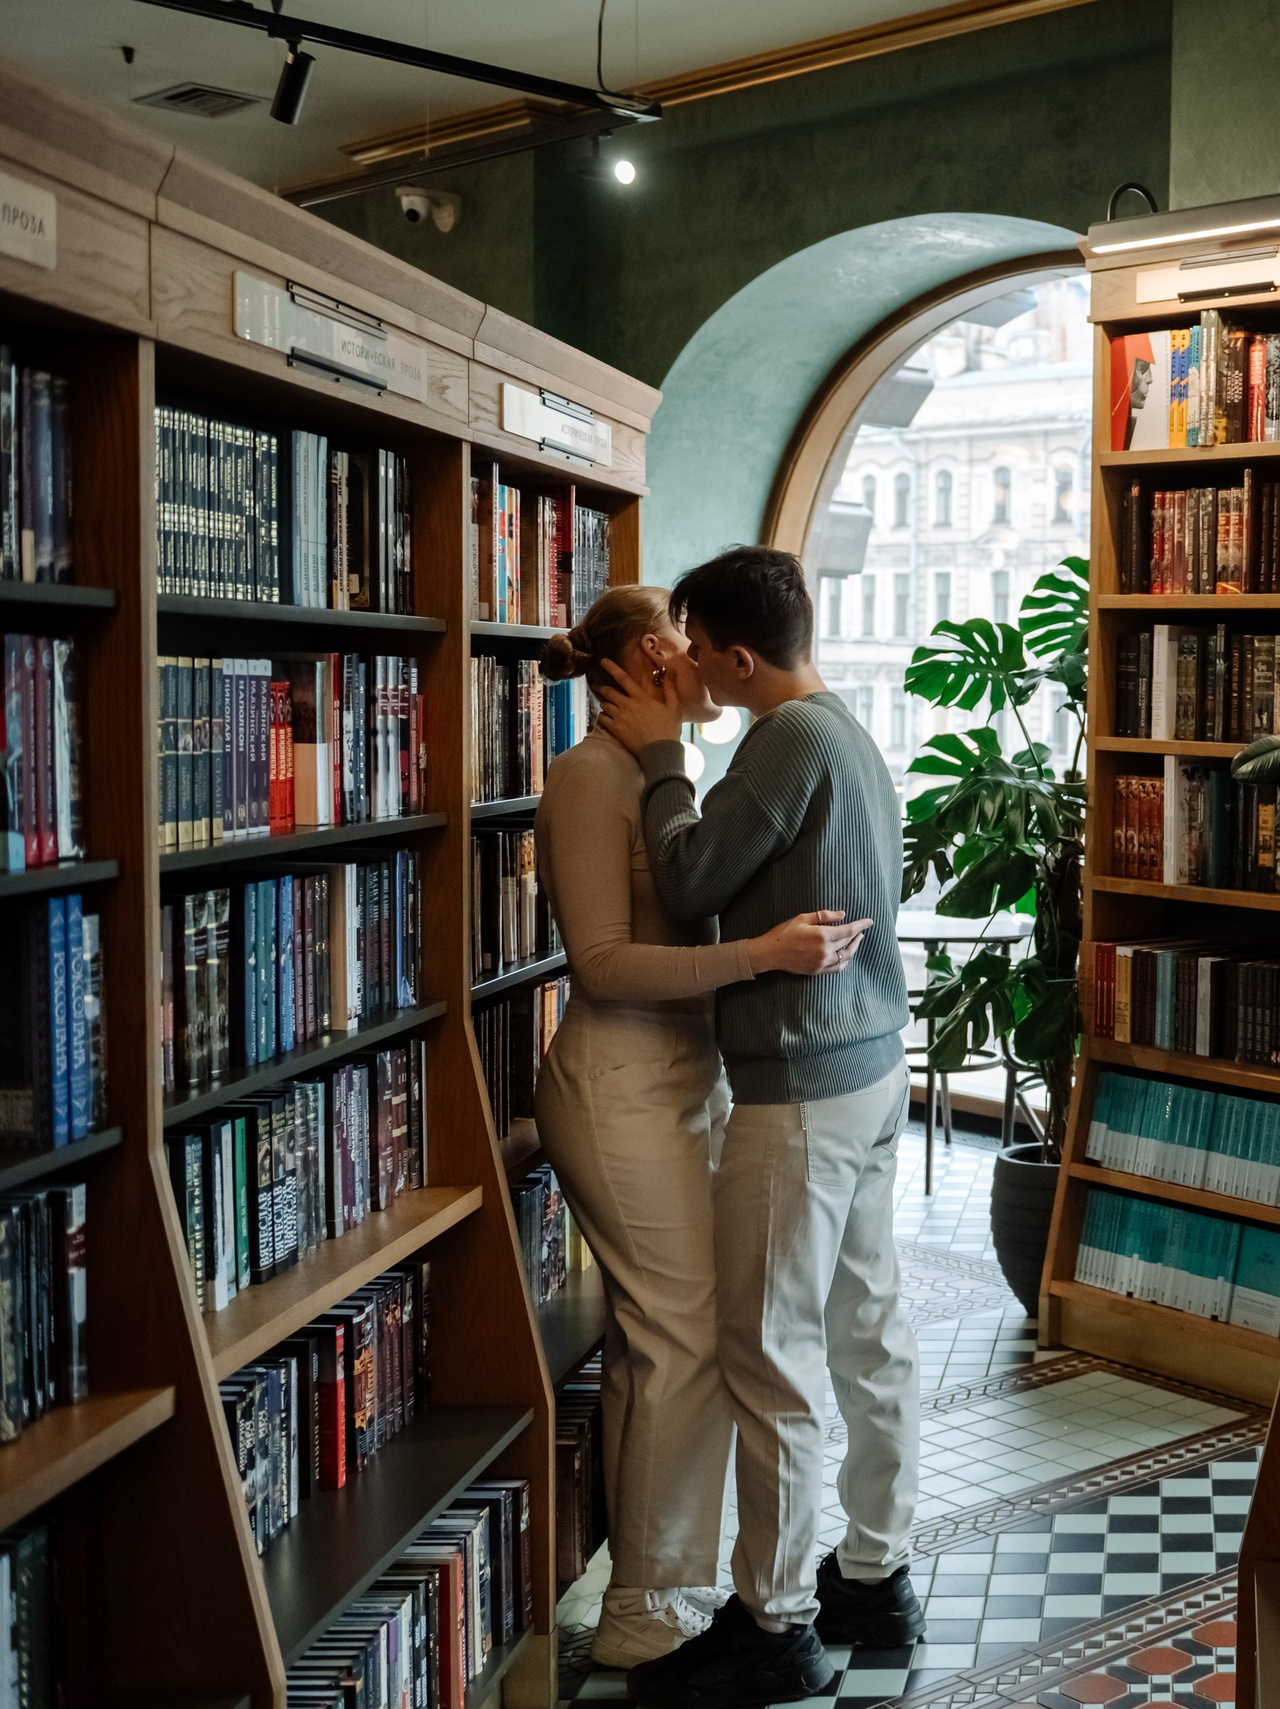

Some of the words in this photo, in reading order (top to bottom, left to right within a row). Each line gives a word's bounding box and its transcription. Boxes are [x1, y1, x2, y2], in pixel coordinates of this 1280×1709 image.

[3, 203, 45, 238] ПРОЗА
[341, 339, 396, 370] ИСТОРИЧЕСКАЯ
[401, 361, 421, 382] ПРОЗА
[224, 678, 232, 741] НИКОЛАЙ
[249, 680, 257, 762] РАДЗИНСКИЙ
[260, 680, 268, 761] РАДЗИНСКИЙ
[225, 744, 231, 752] II
[53, 951, 68, 1077] РОКСОЛАНА
[71, 946, 86, 1070] РОКСОЛАНА
[258, 1192, 269, 1267] ВЯЧЕСЛАВ
[273, 1185, 284, 1260] ВЯЧЕСЛАВ
